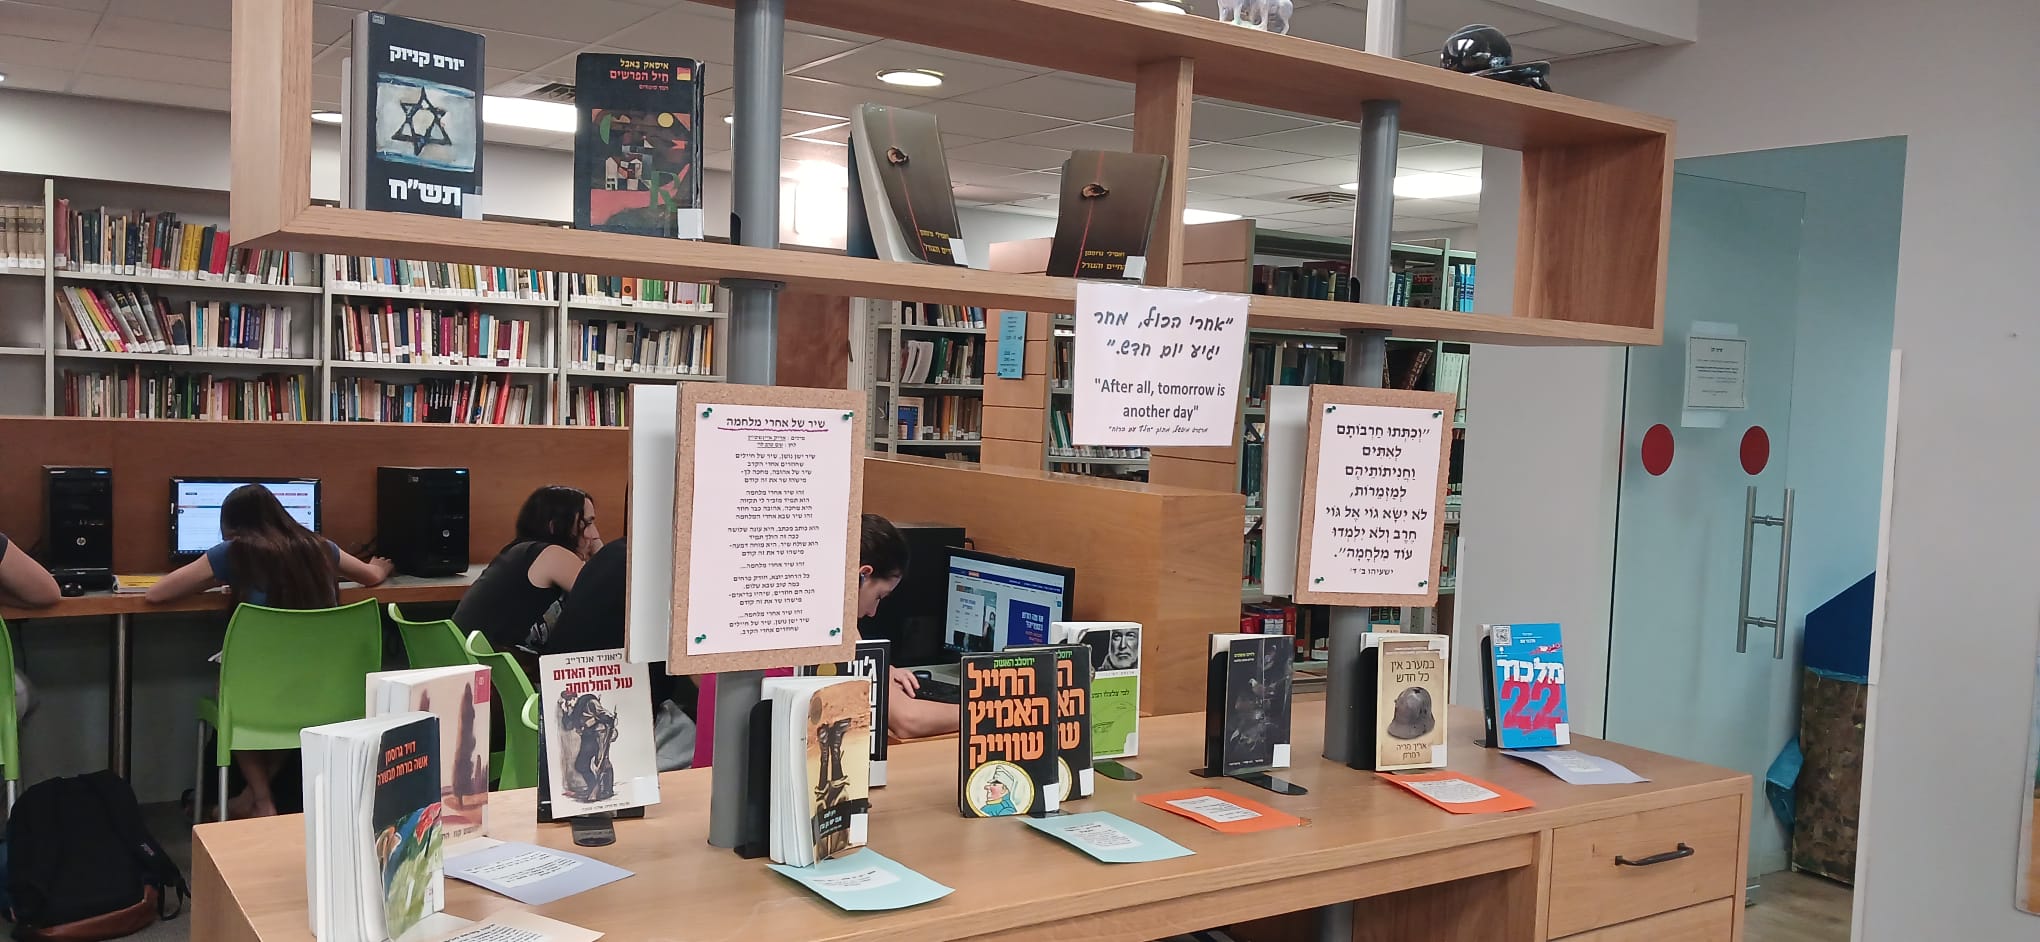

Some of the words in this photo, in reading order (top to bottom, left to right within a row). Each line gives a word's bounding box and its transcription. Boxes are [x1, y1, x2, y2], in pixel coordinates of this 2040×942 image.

[389, 45, 430, 67] קניוק
[433, 54, 464, 71] יורם
[610, 70, 648, 81] הפרשים
[652, 71, 669, 82] חיל
[1094, 310, 1129, 326] מחר
[1159, 343, 1183, 359] יום
[1190, 344, 1220, 361] יגיע
[1095, 377, 1134, 394] "After
[1136, 380, 1154, 396] all,
[1157, 382, 1214, 396] tomorrow
[1217, 383, 1226, 396] is
[1123, 404, 1170, 418] another
[1173, 405, 1199, 422] day"
[726, 417, 761, 427] מלחמה
[765, 418, 788, 427] אחרי
[791, 418, 804, 428] של
[808, 420, 825, 428] שיר
[566, 655, 594, 665] אנדרייב
[1056, 649, 1073, 660] ירוסל
[588, 664, 621, 679] הצחוק
[1390, 660, 1403, 674] אין
[1406, 659, 1435, 670] במערב
[1496, 656, 1565, 685] מלכוד
[553, 667, 586, 681] האדום
[967, 662, 1035, 698] החייל
[1396, 673, 1416, 683] חדש
[1418, 670, 1430, 682] כל
[565, 678, 612, 694] המלחמה
[614, 676, 633, 689] עול
[1500, 676, 1564, 730] 22
[968, 696, 1049, 735] האמיץ
[385, 745, 403, 767] גרוסמן
[968, 731, 1044, 770] שווייק
[396, 760, 413, 777] בורחת
[413, 755, 428, 771] אשה
